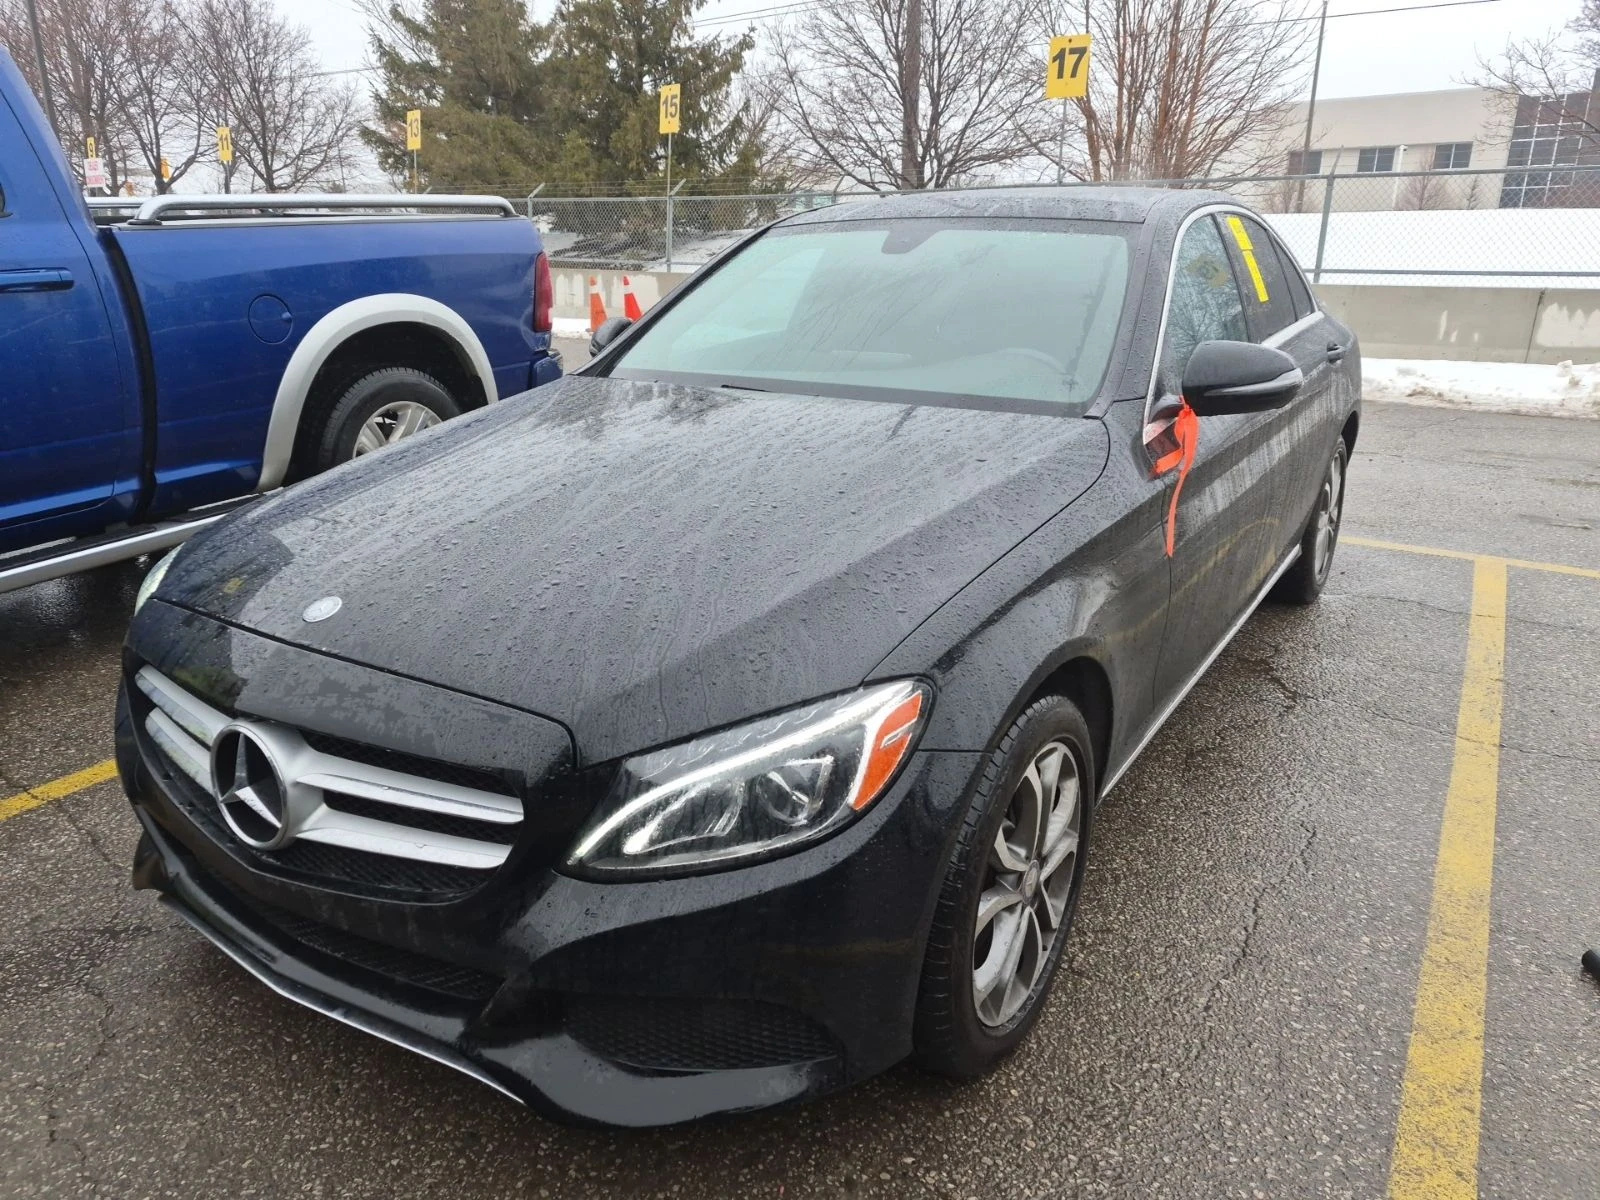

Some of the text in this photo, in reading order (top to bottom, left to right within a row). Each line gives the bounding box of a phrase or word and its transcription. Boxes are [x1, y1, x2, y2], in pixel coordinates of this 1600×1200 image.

[1052, 46, 1088, 79] 17
[662, 94, 678, 119] 15
[409, 118, 419, 138] 13
[219, 134, 229, 151] 11
